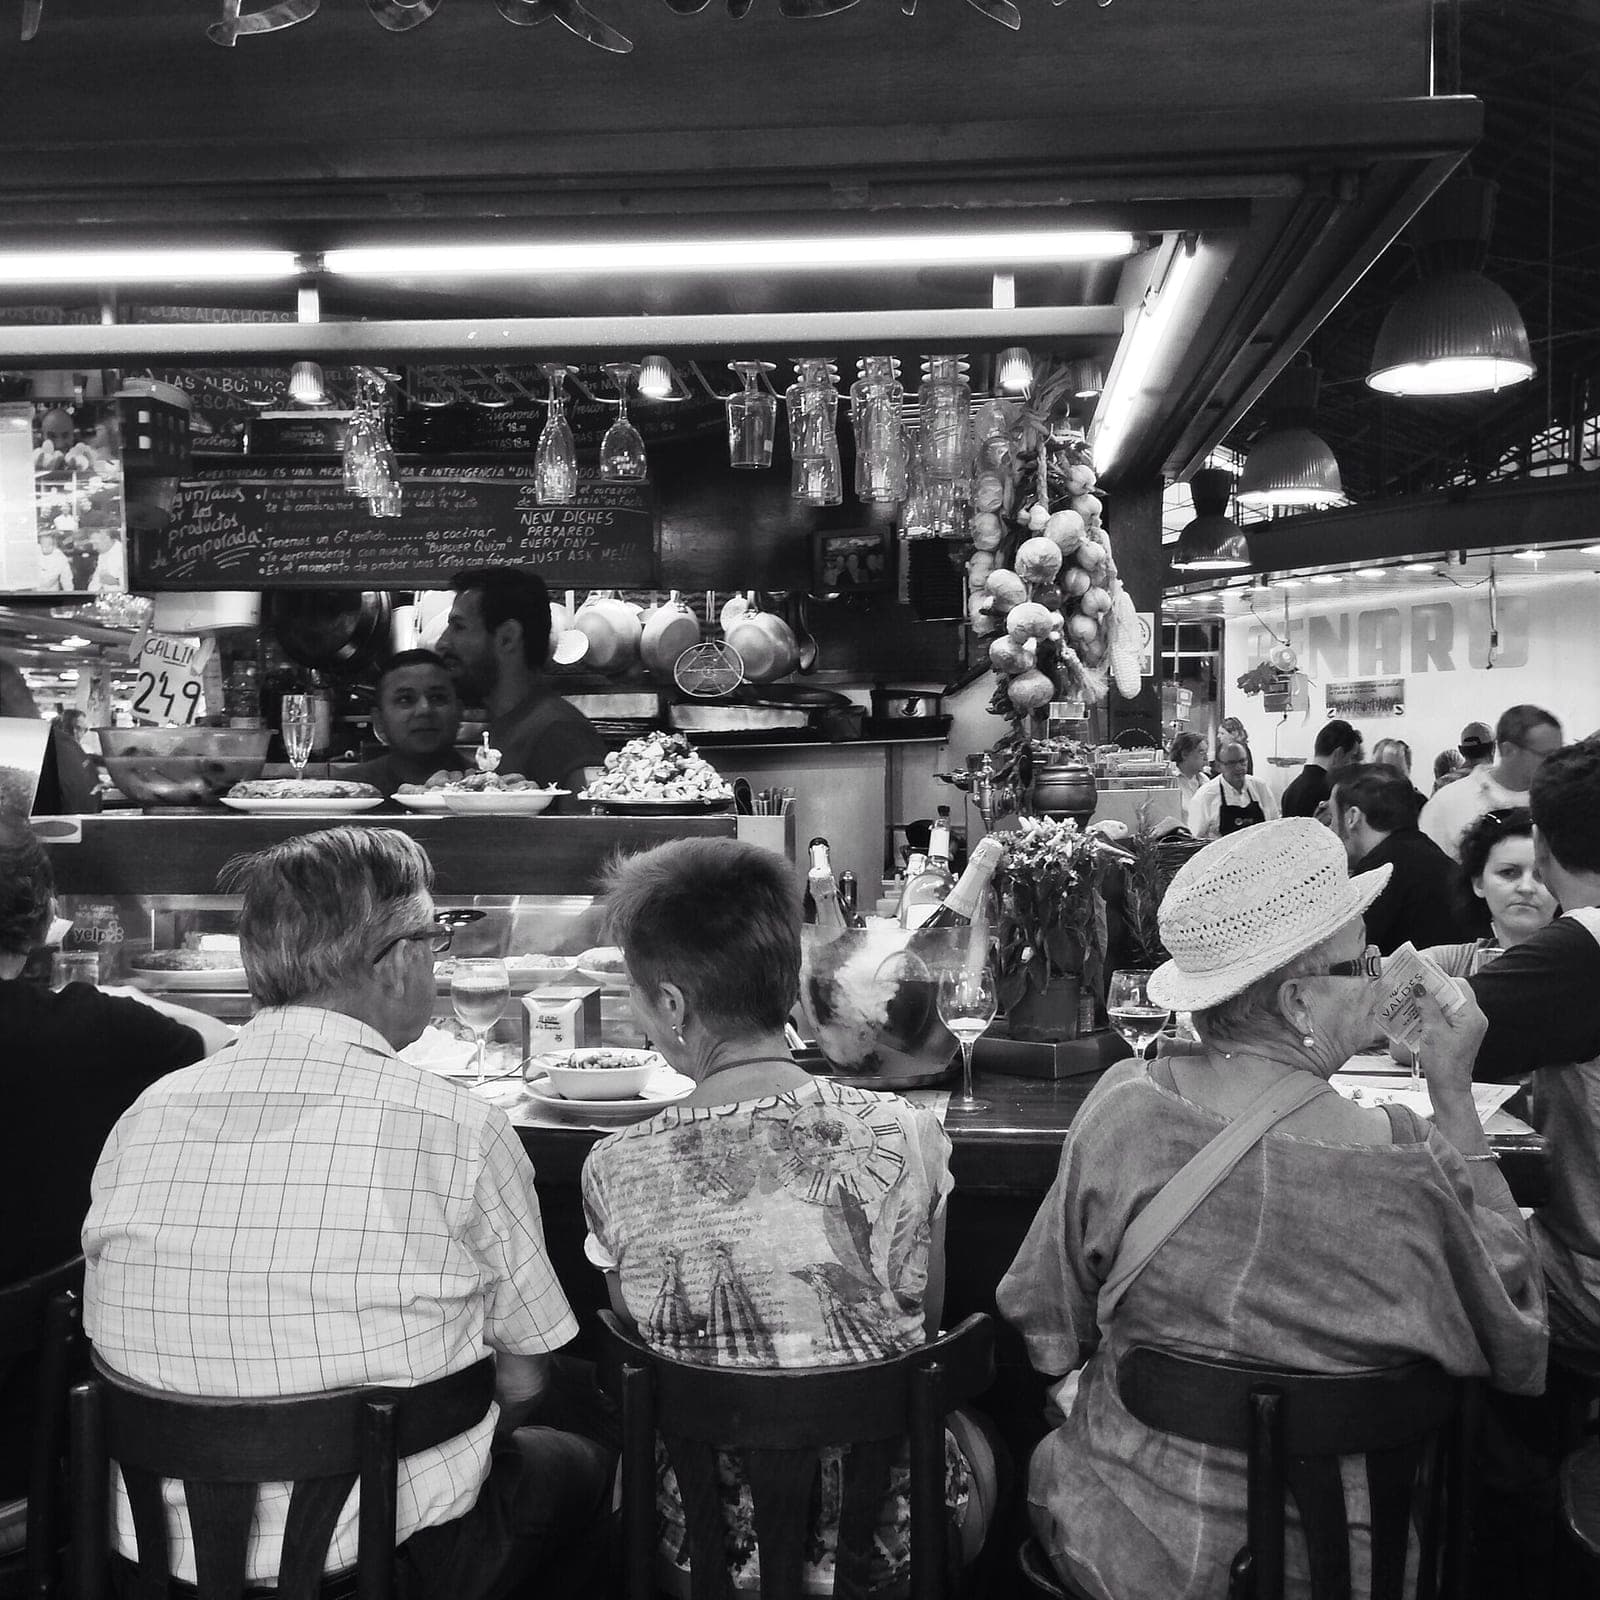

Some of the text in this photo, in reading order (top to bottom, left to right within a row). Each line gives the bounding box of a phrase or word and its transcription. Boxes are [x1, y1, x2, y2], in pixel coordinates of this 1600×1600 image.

[292, 466, 313, 477] UNA
[431, 466, 506, 478] INTELIGENCIA
[520, 510, 615, 526] NEW DISHES
[167, 511, 239, 549] productos
[442, 527, 496, 540] cocinar
[526, 525, 595, 538] PREPARED
[520, 537, 588, 549] EVERY DAY
[526, 550, 563, 565] JUST
[567, 550, 593, 562] ASK
[297, 558, 351, 574] momento
[74, 928, 107, 945] yelp
